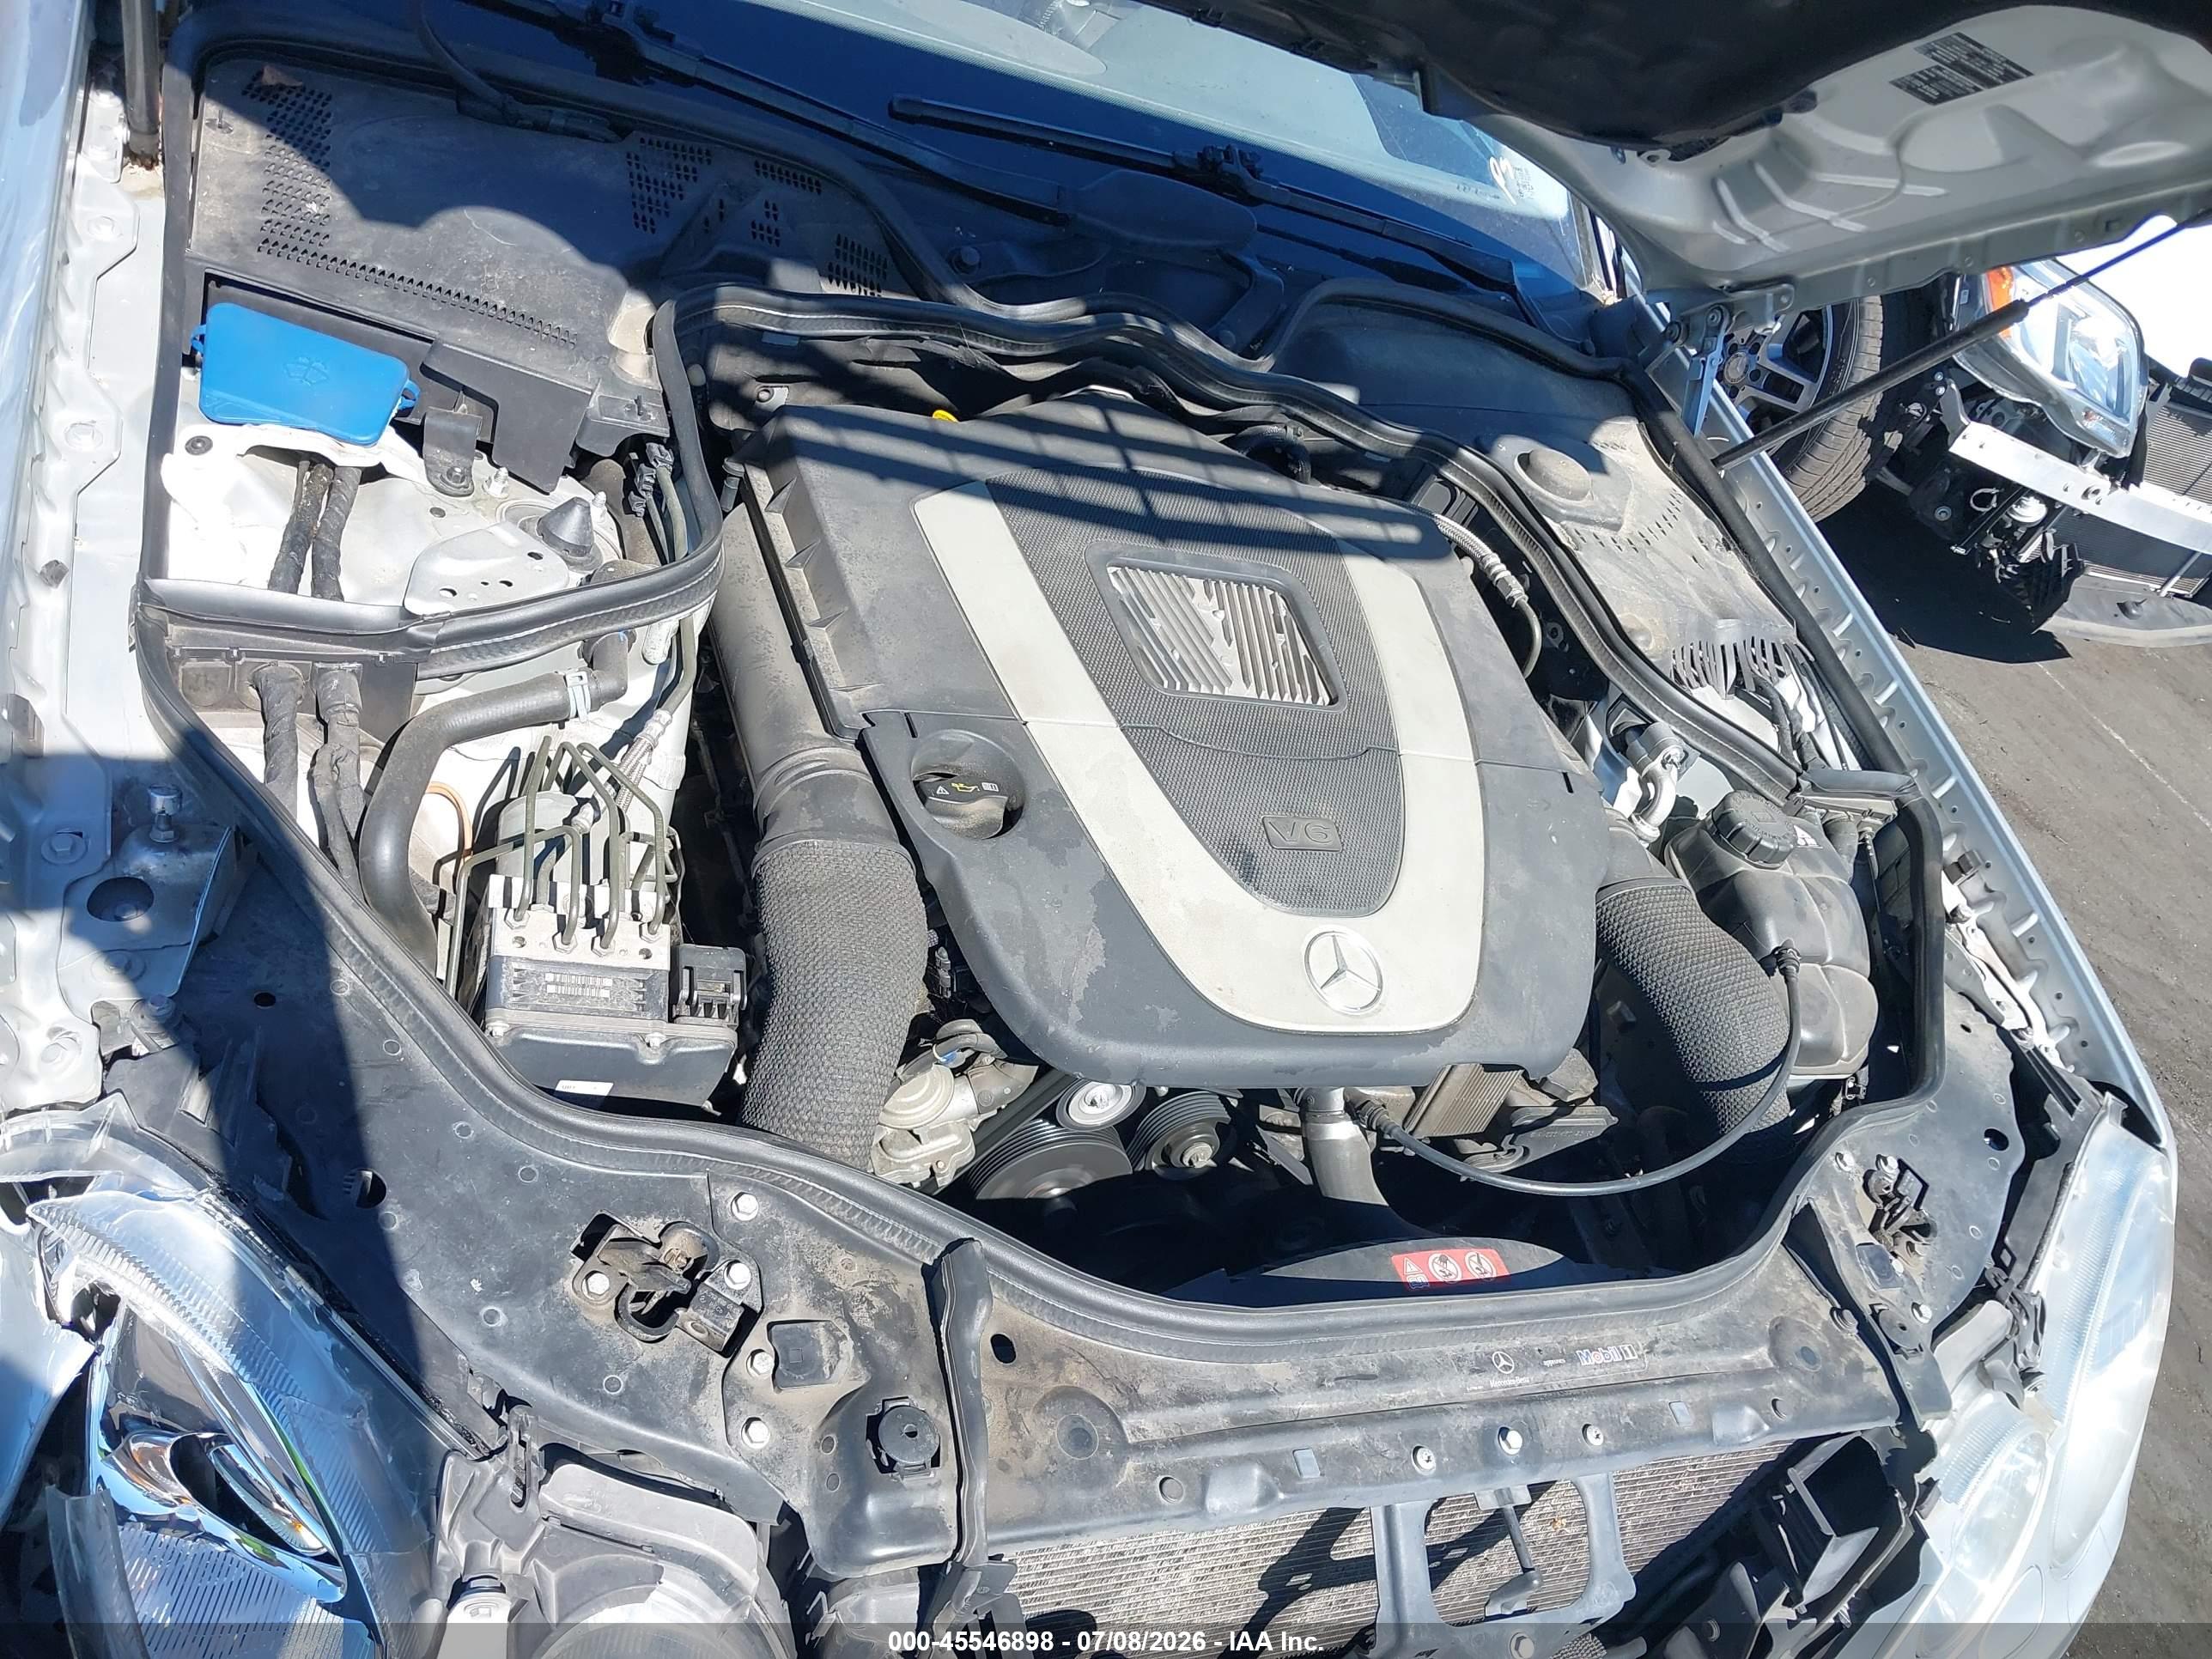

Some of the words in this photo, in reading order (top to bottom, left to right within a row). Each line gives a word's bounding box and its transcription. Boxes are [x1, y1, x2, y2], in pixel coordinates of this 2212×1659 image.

[1268, 821, 1334, 844] V6
[1577, 1346, 1621, 1366] Mobil
[1620, 1344, 1638, 1361] 1
